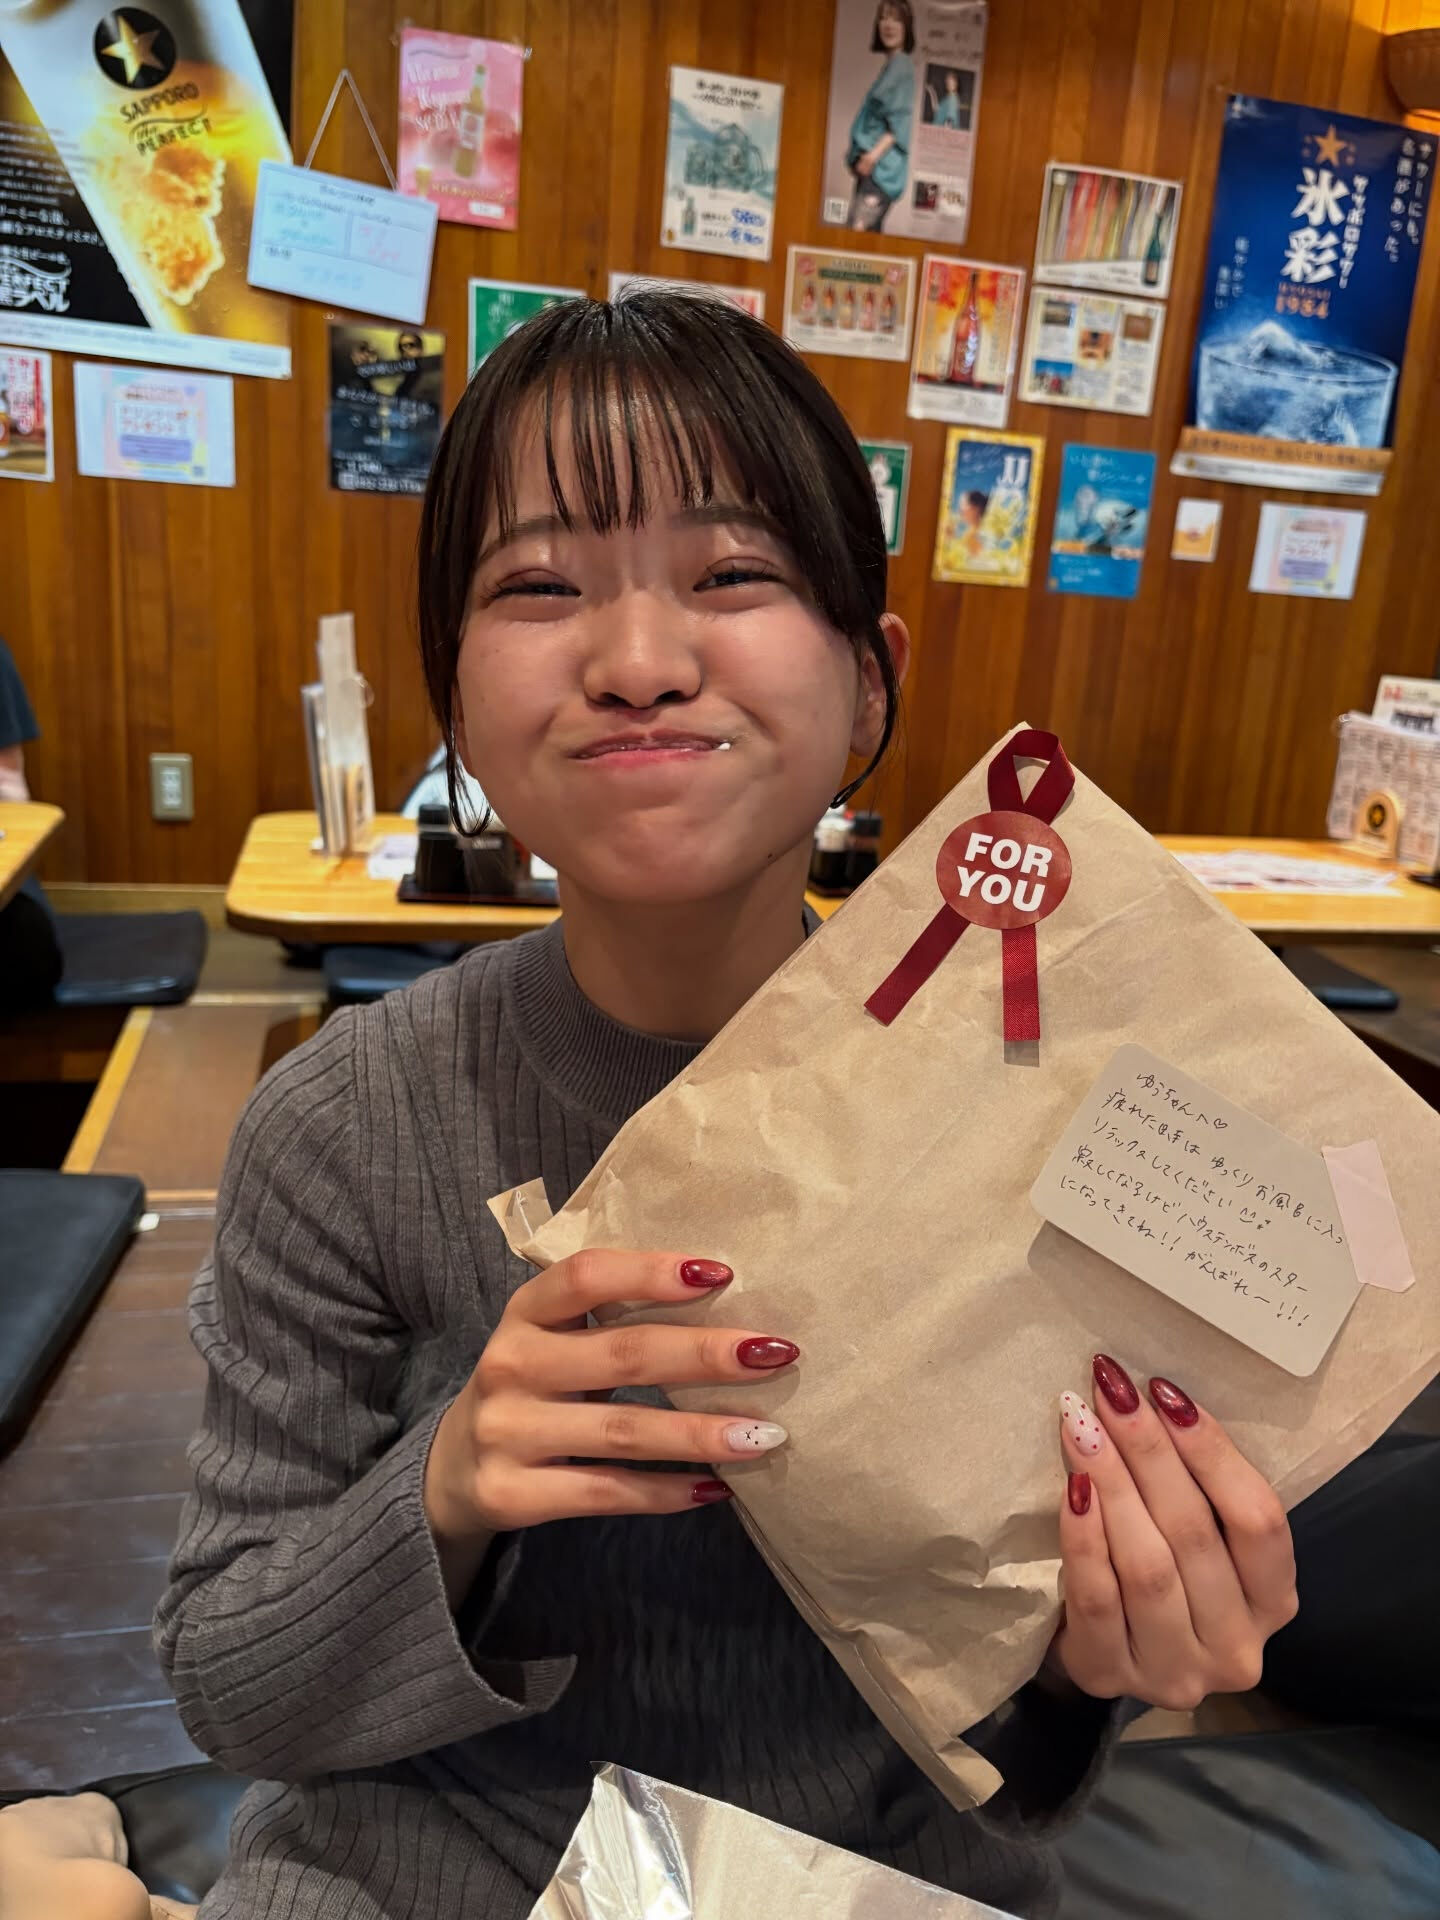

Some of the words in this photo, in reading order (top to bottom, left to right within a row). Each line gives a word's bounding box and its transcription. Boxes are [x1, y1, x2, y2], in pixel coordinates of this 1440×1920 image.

[120, 80, 199, 123] SAPPORO
[137, 117, 212, 156] PERFECT
[1280, 167, 1350, 284] 氷彩
[1339, 174, 1369, 290] サッポロサワー
[1275, 294, 1329, 319] 1984
[965, 832, 1053, 878] FOR
[957, 866, 1046, 912] YOU
